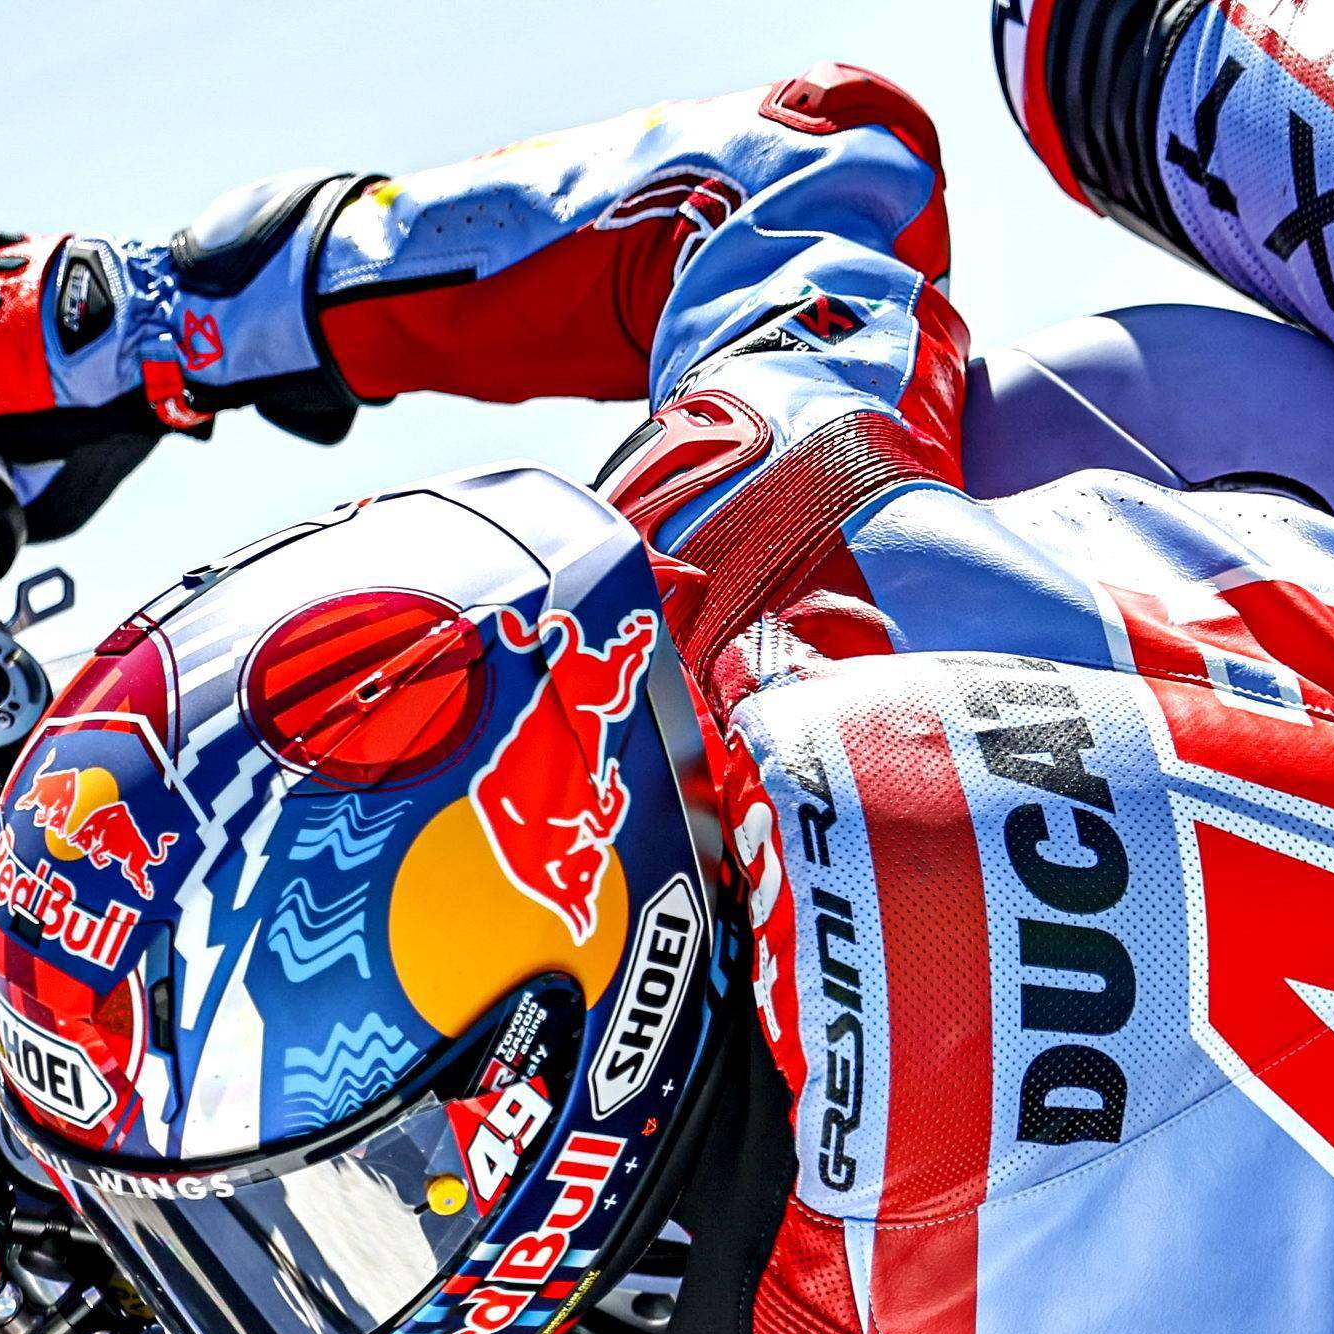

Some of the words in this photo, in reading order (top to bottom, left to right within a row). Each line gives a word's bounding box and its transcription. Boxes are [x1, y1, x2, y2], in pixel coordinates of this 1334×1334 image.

[38, 870, 141, 971] Bull
[496, 992, 533, 1058] TOYOTA
[505, 1001, 539, 1063] GAZOO
[605, 910, 699, 1086] SHOEI
[812, 886, 865, 1193] GRESINI
[89, 1167, 237, 1201] WINGS
[466, 1080, 553, 1201] 49
[489, 1131, 629, 1284] Bull
